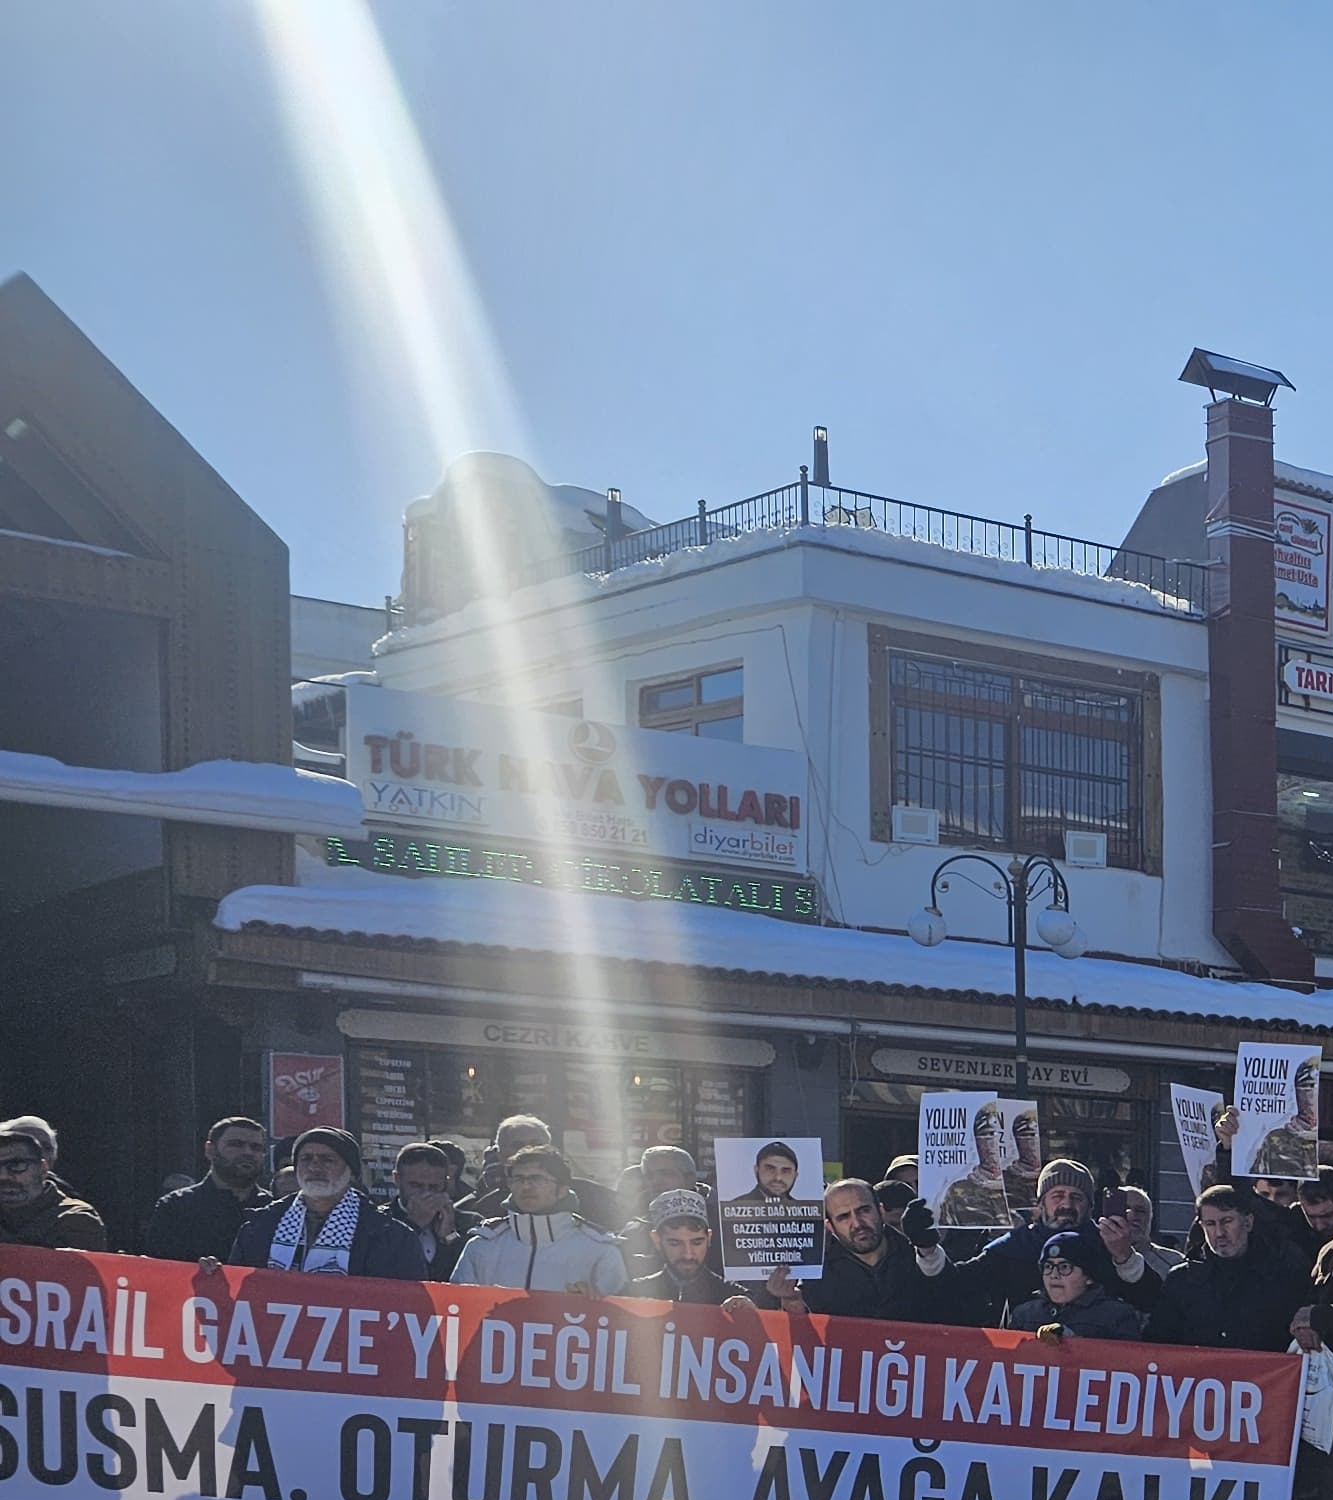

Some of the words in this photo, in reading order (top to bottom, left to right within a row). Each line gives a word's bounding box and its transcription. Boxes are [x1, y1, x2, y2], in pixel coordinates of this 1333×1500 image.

[364, 730, 484, 787] TÜRK
[499, 753, 625, 806] HVA
[638, 774, 800, 829] YOLLARI
[370, 782, 482, 816] YATKIN
[694, 827, 795, 855] diyarbilet
[918, 1057, 1014, 1079] SEVENLER
[1059, 1067, 1093, 1085] EVİ
[1243, 1057, 1289, 1080] YOLUN
[1242, 1080, 1286, 1097] YOLUMUZ
[1175, 1097, 1207, 1122] YOLUN
[1240, 1096, 1252, 1112] EY
[1254, 1095, 1287, 1115] ŞEHİT!
[925, 1107, 967, 1131] YOLUN
[925, 1131, 966, 1147] YOLUMUZ
[925, 1150, 935, 1165] EY
[937, 1148, 967, 1168] ŞEHİT!
[724, 1205, 766, 1218] GAZZE'DE
[767, 1205, 785, 1217] DAĞ
[786, 1206, 821, 1218] YOKTUR.
[733, 1221, 778, 1235] GAZZE'NİN
[779, 1221, 814, 1234] DAĞLARI
[735, 1238, 775, 1249] CESURCA
[776, 1237, 814, 1250] SAVAŞAN
[0, 1276, 165, 1361] SRAİL
[182, 1295, 460, 1383] GAZZE'Yİ
[480, 1311, 642, 1397] DEĞİL
[658, 1322, 925, 1419] İNSANLIĞI
[942, 1356, 1262, 1445] KATLEDİYOR
